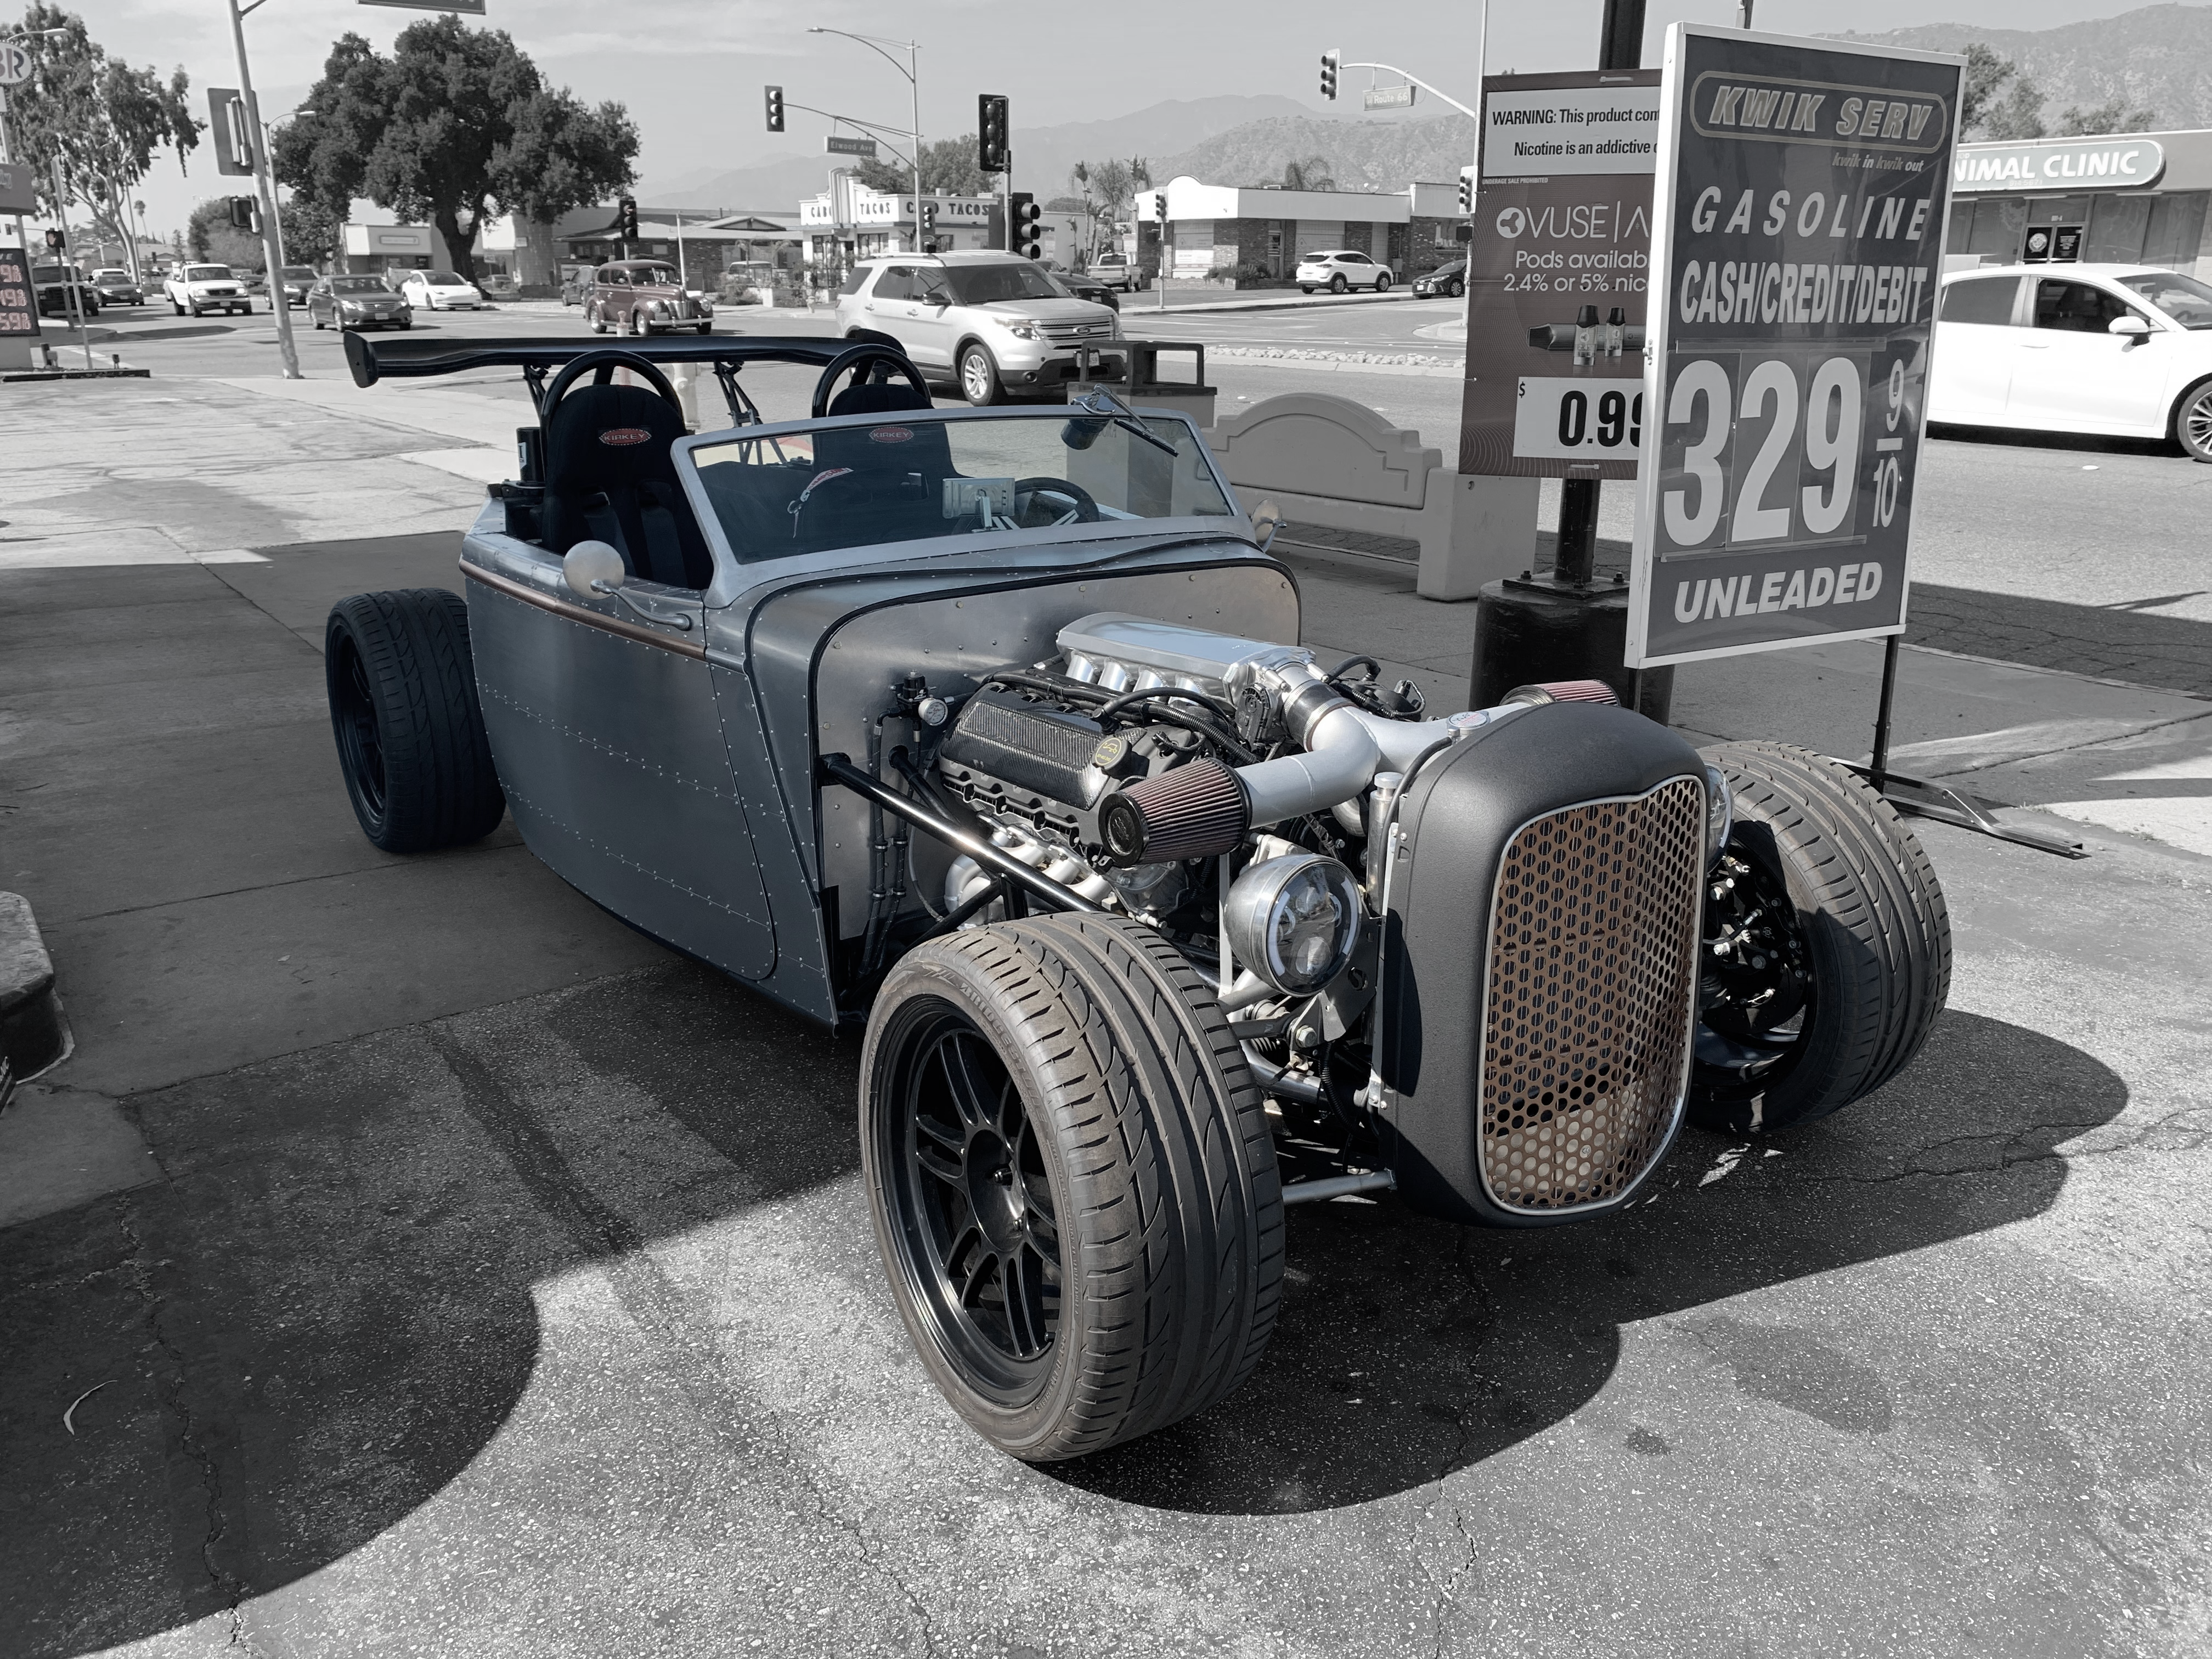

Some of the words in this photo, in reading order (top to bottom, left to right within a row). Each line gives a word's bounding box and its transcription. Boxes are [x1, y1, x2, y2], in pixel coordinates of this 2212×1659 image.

[1374, 94, 1394, 104] Route
[1397, 92, 1408, 101] 66
[1493, 109, 1557, 126] WARNING:
[1559, 109, 1584, 123] This
[1587, 108, 1633, 126] product
[1708, 85, 1826, 132] KWIK
[1836, 97, 1933, 140] SERV
[830, 141, 856, 150] Elwood
[1514, 142, 1563, 156] Nicotine
[1565, 141, 1576, 155] is
[1578, 144, 1593, 154] an
[1595, 139, 1651, 154] addictive
[1832, 152, 1861, 167] kwik
[1862, 154, 1874, 168] in
[1876, 155, 1904, 170] kwik
[1905, 160, 1924, 172] out
[2044, 151, 2139, 178] CLINIC
[811, 205, 832, 218] CAB
[860, 202, 890, 216] TACOS
[949, 203, 989, 216] TACOS
[1691, 185, 1931, 241] GASOLINE
[1526, 205, 1609, 238] VUSE
[1515, 250, 1563, 269] Pods
[1504, 274, 1548, 292] 2.4%
[1554, 276, 1576, 292] or
[1579, 274, 1610, 292] 5%
[1615, 274, 1648, 291] nic
[1680, 259, 1928, 324] CASH/CREDIT/DEBIT
[1663, 357, 1861, 546] 329
[1674, 561, 1883, 623] UNLEADED
[960, 981, 1047, 1123] BRIDGESTONE
